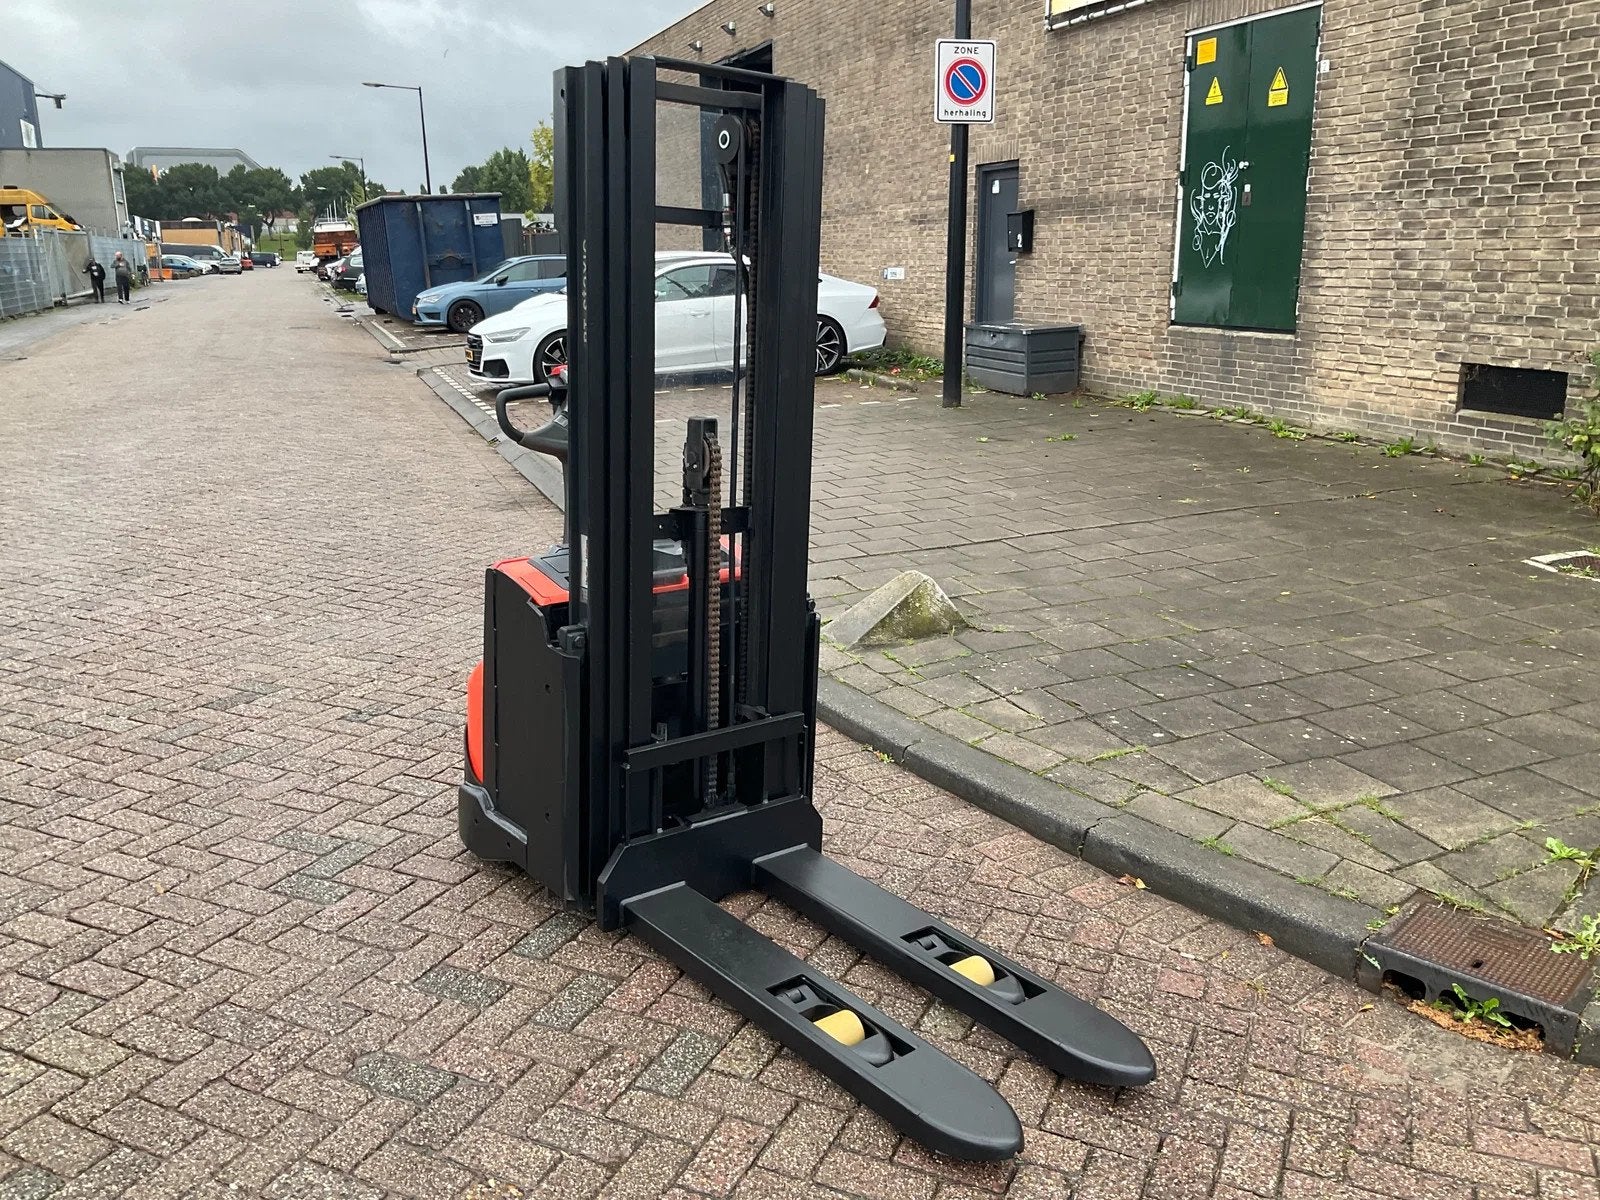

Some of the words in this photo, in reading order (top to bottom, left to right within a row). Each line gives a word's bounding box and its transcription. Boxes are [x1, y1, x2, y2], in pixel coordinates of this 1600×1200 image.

[954, 46, 979, 54] ZONE
[944, 109, 987, 118] herhaling
[1017, 233, 1023, 248] 2
